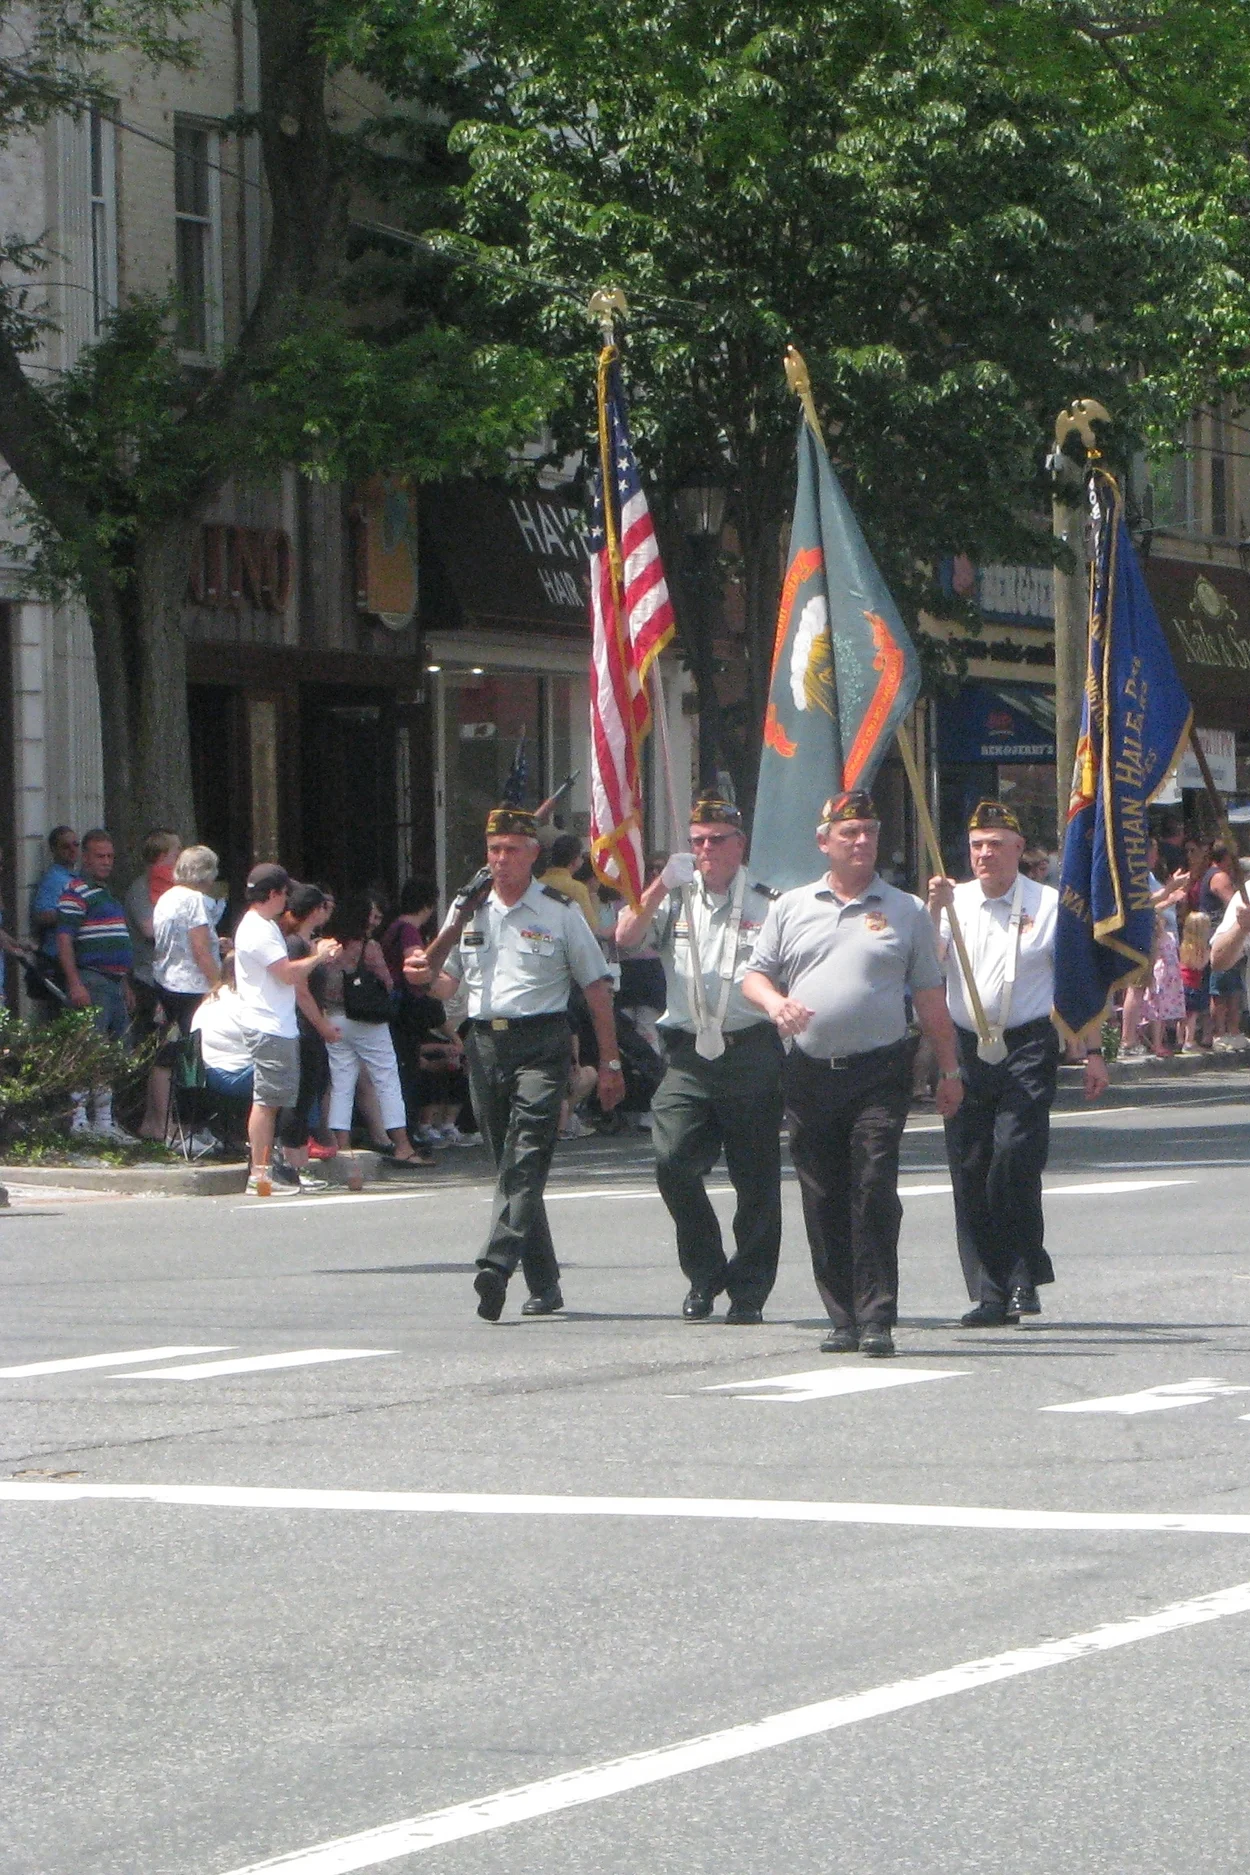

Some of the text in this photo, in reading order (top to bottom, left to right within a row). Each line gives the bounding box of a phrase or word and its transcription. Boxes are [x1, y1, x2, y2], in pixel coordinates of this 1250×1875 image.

[537, 567, 585, 607] HAIR
[1114, 711, 1145, 788] HALE
[1121, 798, 1151, 911] NATHAN
